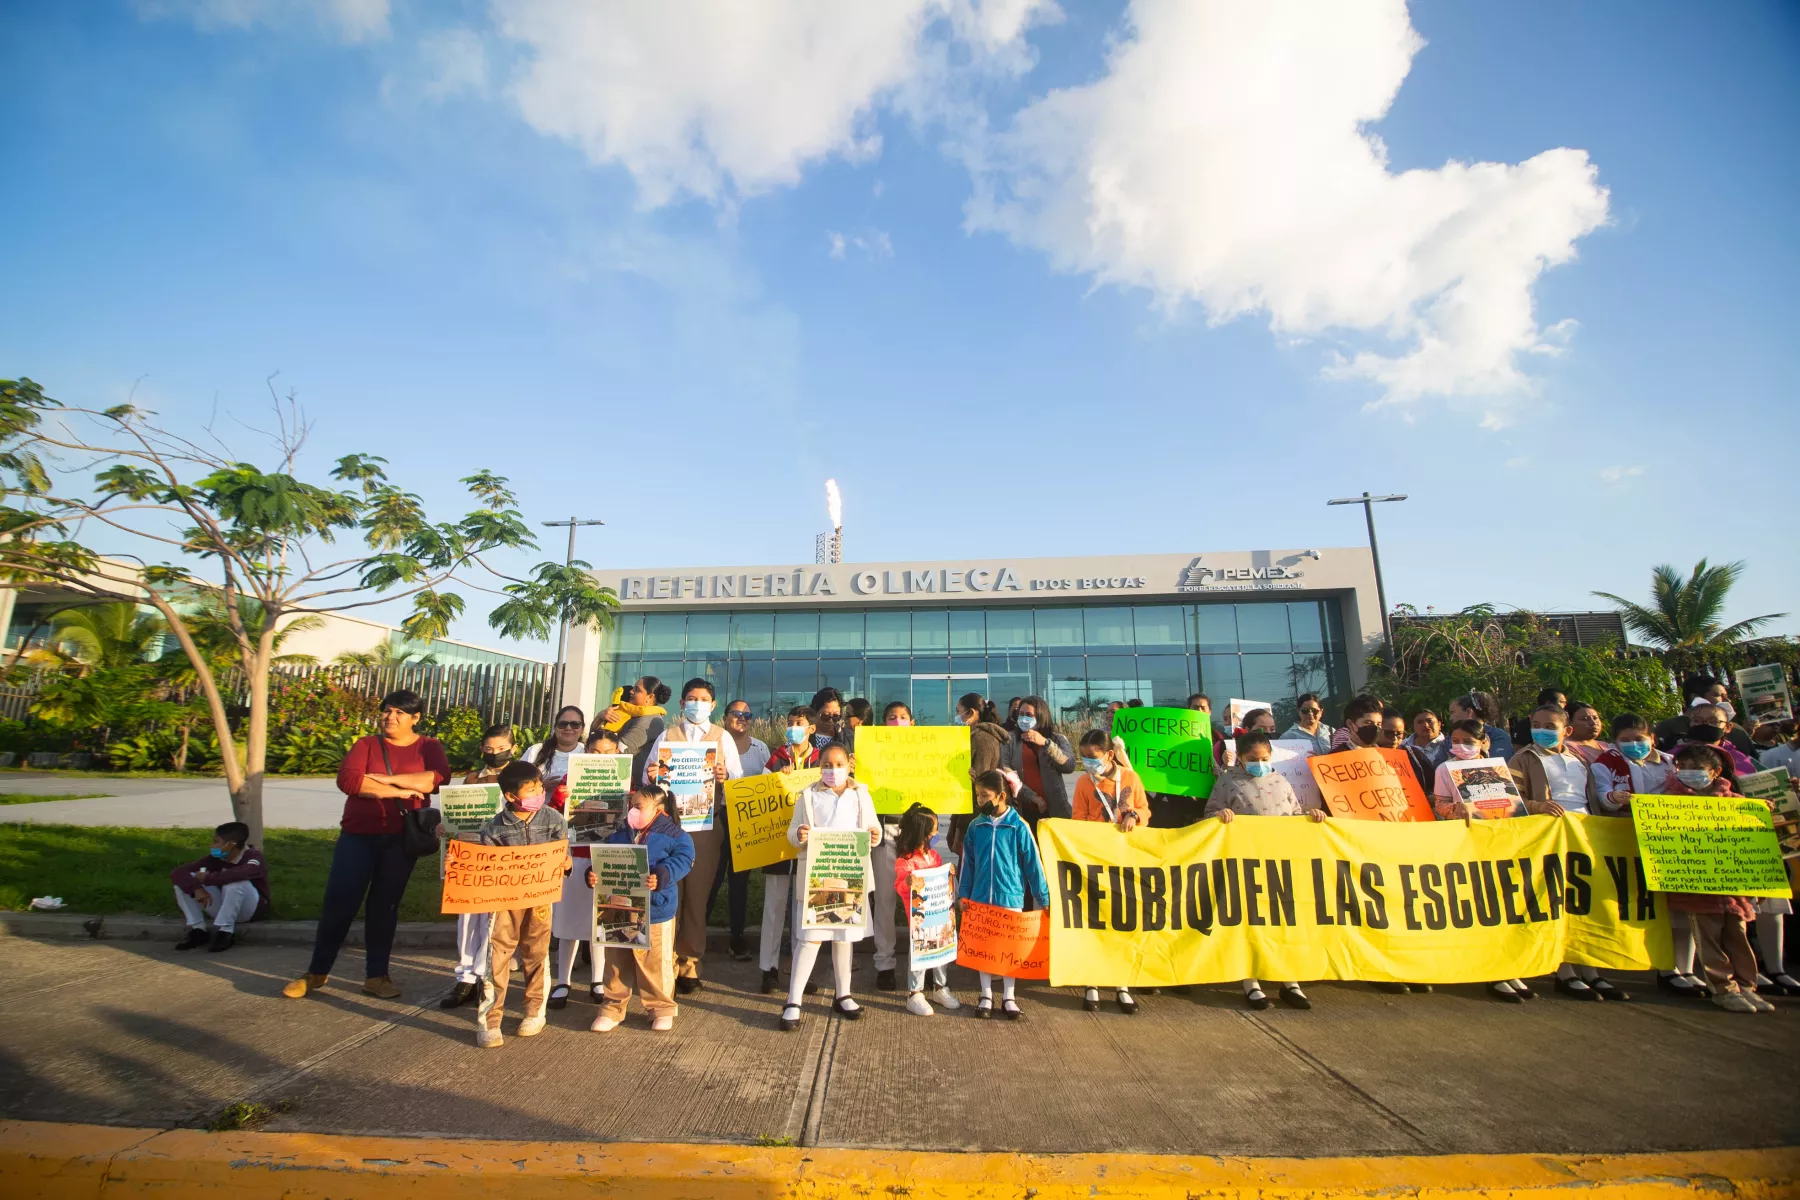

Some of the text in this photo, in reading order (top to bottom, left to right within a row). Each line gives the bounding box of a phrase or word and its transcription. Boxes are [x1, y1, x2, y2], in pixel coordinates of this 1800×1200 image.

[1223, 566, 1294, 580] PEMEX
[623, 567, 1024, 599] REFINERÍA OLMECA
[1034, 575, 1149, 591] DOS BOCAS
[1116, 715, 1208, 738] NO CIERREN
[875, 731, 937, 745] LA LUCHA
[1146, 748, 1214, 775] ESCUELA
[1359, 787, 1415, 809] CIERRE
[1703, 800, 1713, 810] de
[1717, 801, 1727, 812] la
[1638, 809, 1680, 821] Claudia
[735, 827, 748, 841] de
[1641, 821, 1652, 831] Sr
[1656, 821, 1709, 833] Gobernador
[1714, 822, 1727, 832] del
[1640, 832, 1675, 842] Javier
[1680, 833, 1702, 846] May
[477, 852, 497, 861] me
[501, 850, 548, 862] cierren
[552, 846, 565, 855] mi
[1645, 844, 1678, 855] Padres
[1681, 845, 1692, 855] de
[508, 860, 546, 870] mejor
[603, 862, 611, 870] No
[1714, 857, 1724, 865] la
[1651, 865, 1662, 874] de
[1666, 866, 1708, 875] nuestras
[447, 868, 563, 887] REUBIQUENLA
[1680, 875, 1717, 884] nuestras
[1720, 875, 1748, 883] clases
[1751, 874, 1760, 882] de
[628, 881, 641, 889] gran
[1703, 883, 1739, 892] nuestros
[1057, 851, 1656, 937] REUBIQUEN LAS ESCUELAS YA
